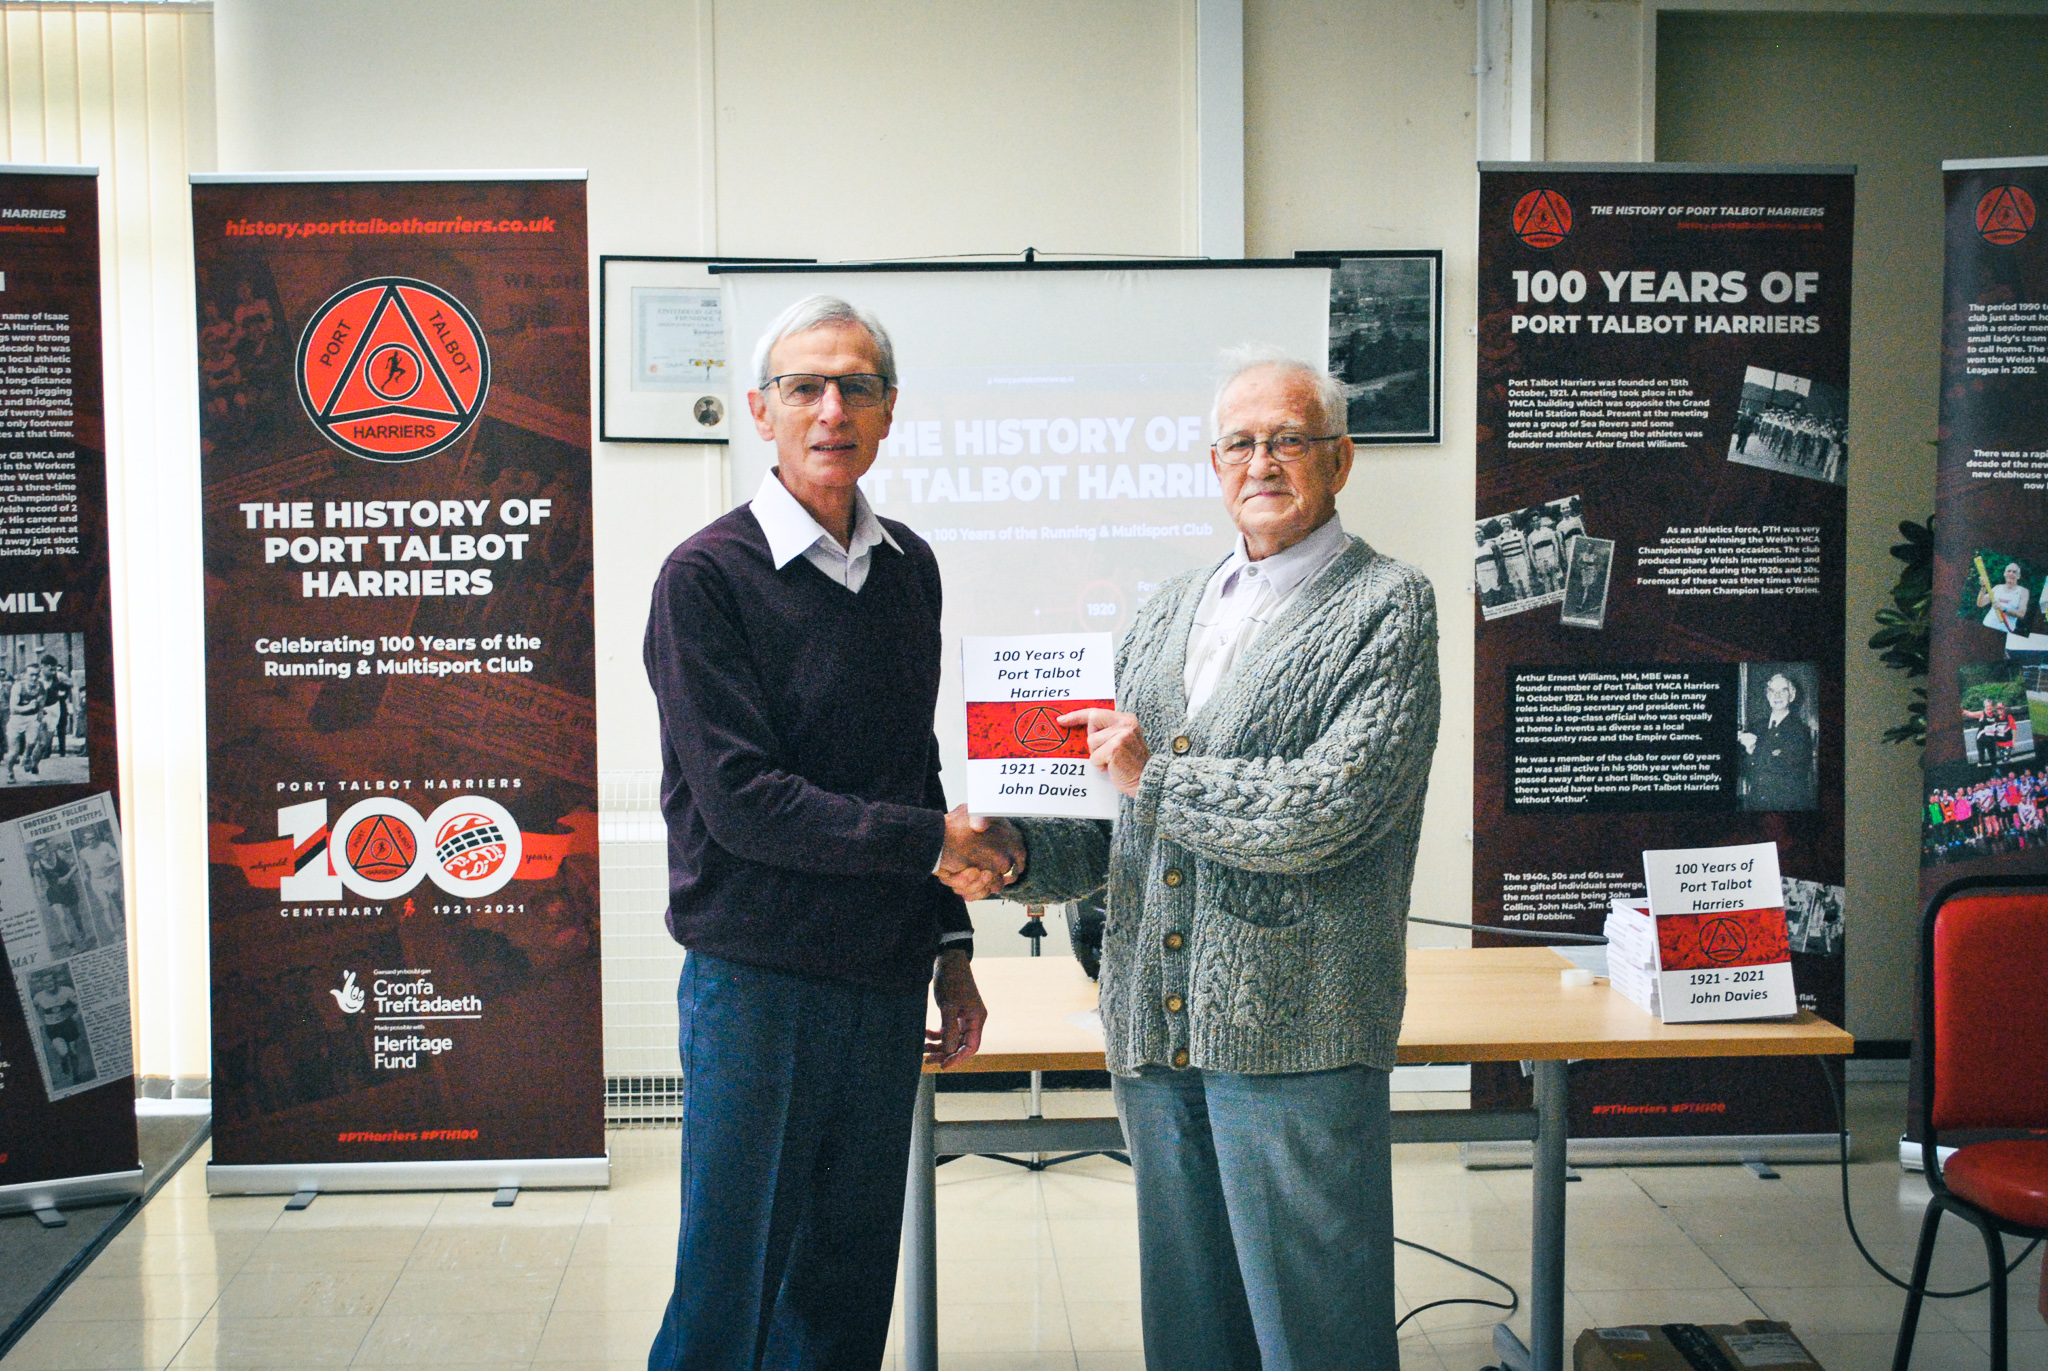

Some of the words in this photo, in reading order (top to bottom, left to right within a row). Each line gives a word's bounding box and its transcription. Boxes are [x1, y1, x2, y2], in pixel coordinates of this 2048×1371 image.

[2, 209, 66, 219] HARRIERS
[1590, 205, 1614, 215] THE
[1615, 206, 1666, 215] HISTORY
[1667, 206, 1684, 216] OF
[1686, 206, 1718, 216] PORT
[1720, 207, 1765, 216] TALBOT
[1767, 207, 1824, 216] HARRIERS
[226, 217, 556, 236] history.porttalbotharriers.co.uk
[1512, 270, 1587, 303] 100
[1599, 271, 1748, 303] YEARS
[1761, 272, 1819, 303] OF
[1511, 315, 1582, 334] PORT
[1587, 315, 1688, 334] TALBOT
[1695, 315, 1820, 333] HARRIERS
[319, 319, 354, 367] PORT
[430, 310, 473, 375] TALBOT
[1967, 335, 1992, 343] small
[1966, 366, 1999, 376] League
[2001, 365, 2010, 374] in
[2012, 366, 2037, 374] 2002.
[5, 376, 72, 386] long-distance
[1508, 379, 1528, 387] Port
[1530, 379, 1559, 387] Talbot
[1560, 379, 1597, 387] Harriers
[1617, 379, 1656, 387] founded
[353, 425, 436, 439] HARRIERS
[887, 420, 944, 457] HE
[954, 416, 1135, 456] HISTORY
[1145, 415, 1202, 453] OF
[902, 464, 1068, 504] TALBOT
[1078, 462, 1223, 500] HARRI
[7, 494, 77, 503] Championship
[239, 502, 314, 529] THE
[325, 500, 491, 528] HISTORY
[500, 499, 552, 525] OF
[934, 527, 957, 542] 100
[959, 527, 997, 541] Years
[998, 526, 1016, 541] of
[1015, 526, 1038, 541] the
[1040, 524, 1097, 542] Running
[1099, 524, 1109, 538] &
[1111, 523, 1180, 540] Multisport
[1182, 522, 1213, 536] Club
[1660, 536, 1708, 544] successful
[1709, 535, 1747, 545] winning
[1748, 536, 1764, 544] the
[0, 548, 42, 557] birthday
[43, 547, 54, 555] in
[55, 547, 79, 555] 1945.
[265, 536, 369, 563] PORT
[377, 534, 529, 561] TALBOT
[302, 569, 493, 597] HARRIERS
[1086, 603, 1117, 617] 1920
[255, 636, 375, 655] Celebrating
[379, 636, 415, 652] 100
[419, 636, 477, 651] Years
[481, 634, 503, 650] of
[506, 634, 542, 650] the
[993, 651, 1021, 662] 100
[1025, 650, 1065, 661] Years
[1069, 648, 1086, 662] of
[265, 659, 351, 679] Running
[356, 660, 371, 675] &
[377, 658, 482, 676] Multisport
[486, 657, 534, 673] Club
[998, 669, 1029, 680] Port
[1034, 667, 1081, 679] Talbot
[1516, 674, 1546, 682] Arthur
[1547, 674, 1576, 682] Ernest
[1578, 673, 1619, 681] Williams,
[1621, 673, 1640, 681] MM,
[1641, 672, 1661, 680] MBE
[1010, 687, 1070, 698] Harriers
[1516, 684, 1552, 692] founder
[1553, 684, 1591, 692] member
[1592, 683, 1603, 691] of
[1604, 683, 1623, 691] Port
[1655, 682, 1682, 690] YMCA
[1684, 682, 1720, 690] Harriers
[1515, 705, 1539, 713] roles
[1540, 704, 1582, 713] including
[1583, 704, 1625, 712] secretary
[1627, 703, 1644, 711] and
[1645, 703, 1691, 712] president.
[1515, 736, 1577, 744] cross-country
[1600, 734, 1617, 742] and
[1635, 733, 1668, 742] Empire
[1669, 733, 1703, 741] Games.
[1000, 763, 1035, 775] 1921
[1050, 763, 1085, 776] 2021
[277, 781, 326, 792] PORT
[338, 780, 412, 791] TALBOT
[425, 778, 522, 789] HARRIERS
[999, 783, 1034, 795] John
[1038, 784, 1087, 797] Davies
[23, 814, 58, 830] BROTHERS
[61, 804, 88, 818] FOLLOW
[66, 809, 103, 827] FOOTSTEPS
[277, 795, 523, 902] 100
[1675, 863, 1698, 875] 100
[1701, 863, 1737, 873] Years
[1740, 858, 1754, 873] of
[1529, 882, 1557, 892] gifted
[1558, 882, 1607, 890] individuals
[1608, 882, 1647, 890] emerge,
[1680, 882, 1707, 893] Port
[1711, 879, 1752, 891] Talbot
[280, 907, 383, 917] CENTENARY
[433, 904, 524, 914] 1921-2021
[1503, 903, 1536, 911] Collins,
[1537, 903, 1560, 911] John
[1561, 902, 1587, 910] Nash,
[1692, 899, 1744, 911] Harriers
[1503, 913, 1521, 921] and
[1522, 913, 1535, 921] Dil
[1537, 912, 1576, 920] Robbins.
[1690, 973, 1721, 985] 1921
[1733, 970, 1764, 983] 2021
[373, 979, 434, 996] Cronfa
[373, 995, 482, 1013] Treftadaeth
[1690, 992, 1721, 1004] John
[1725, 990, 1768, 1002] Davies
[374, 1036, 453, 1056] Heritage
[374, 1053, 417, 1069] Fund
[338, 1131, 418, 1142] #PTHarriers
[421, 1129, 479, 1140] #PTH100
